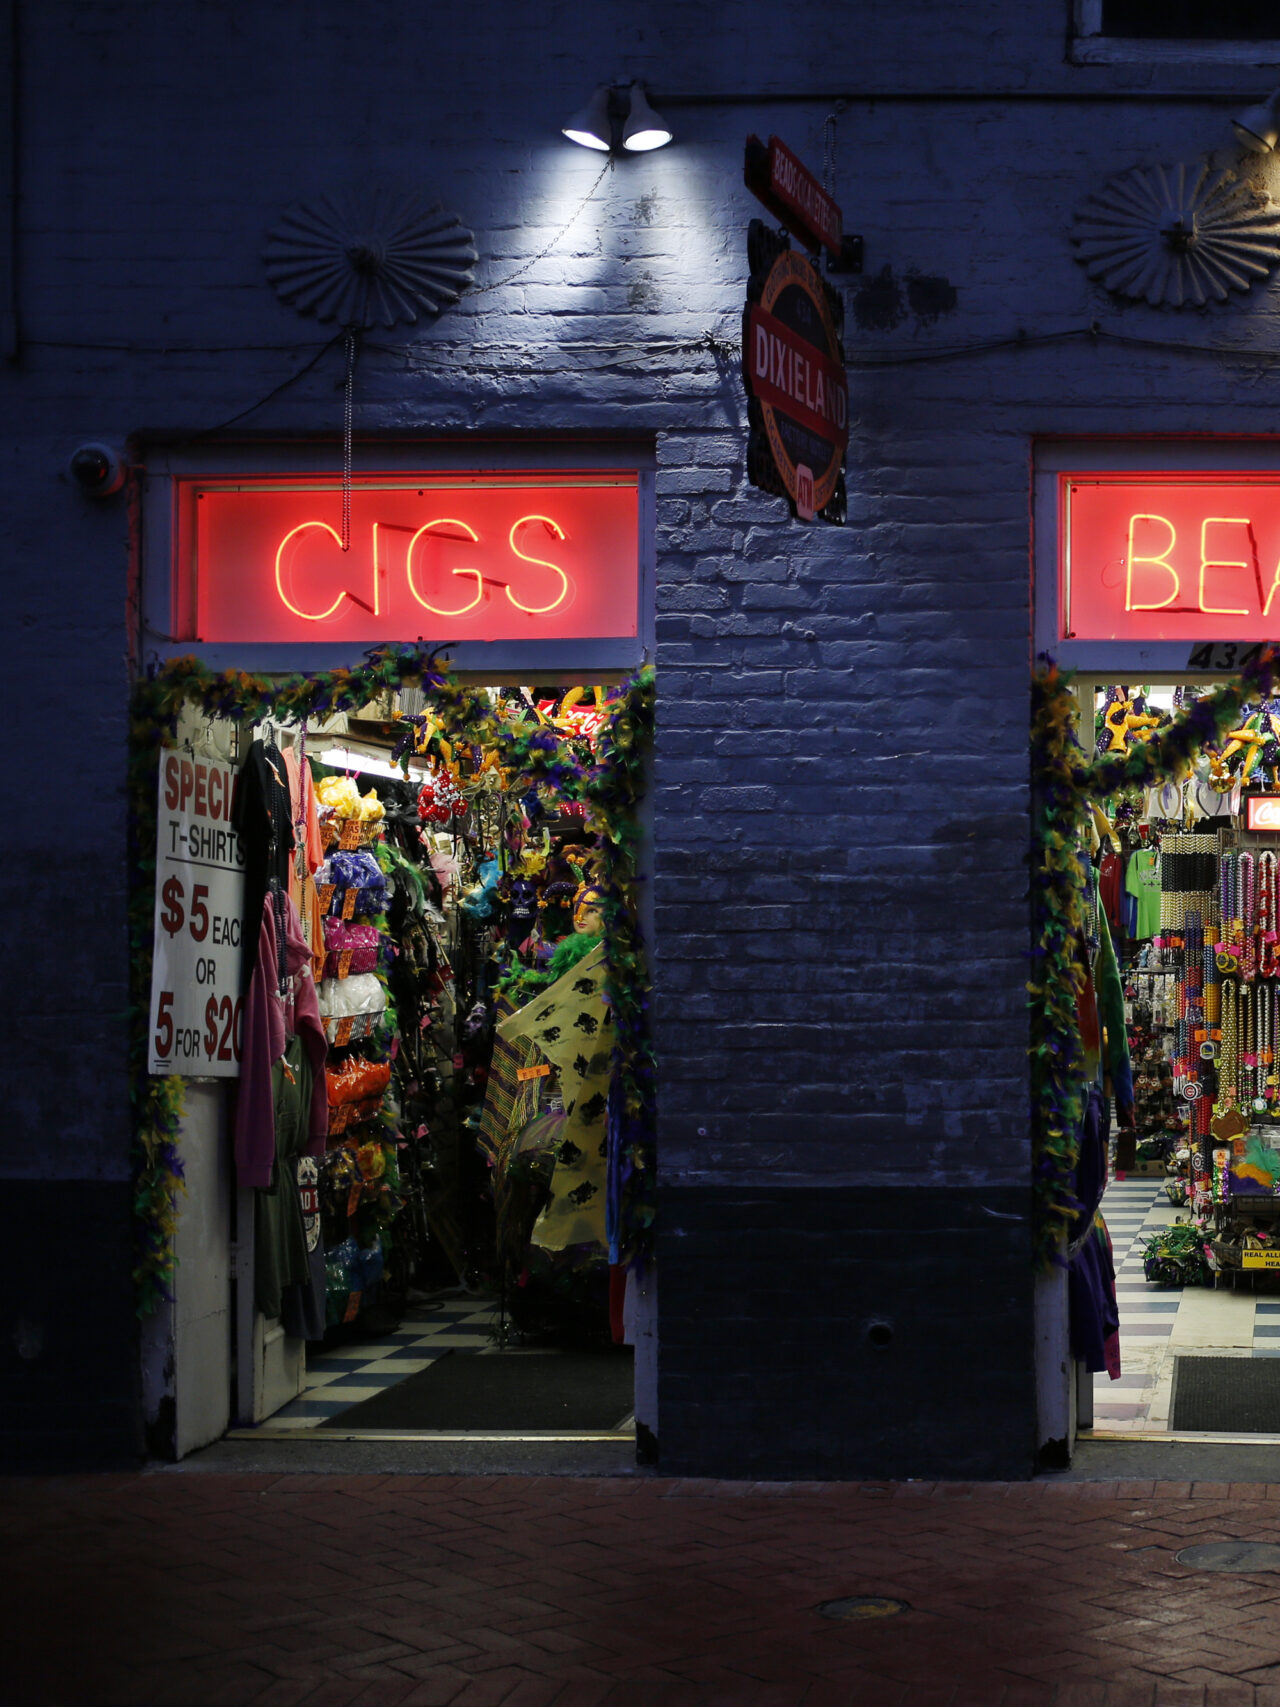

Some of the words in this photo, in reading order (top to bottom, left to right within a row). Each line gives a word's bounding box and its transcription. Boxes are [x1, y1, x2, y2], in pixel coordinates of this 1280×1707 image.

[755, 322, 847, 430] DIXIELAND
[796, 474, 814, 511] ATM
[274, 514, 569, 620] CIGS
[169, 820, 247, 866] T-SHIRTS
[212, 915, 245, 948] EAC
[195, 957, 217, 985] OR
[154, 991, 174, 1059] 5
[174, 1028, 201, 1058] FOR
[1244, 1251, 1264, 1259] REAL
